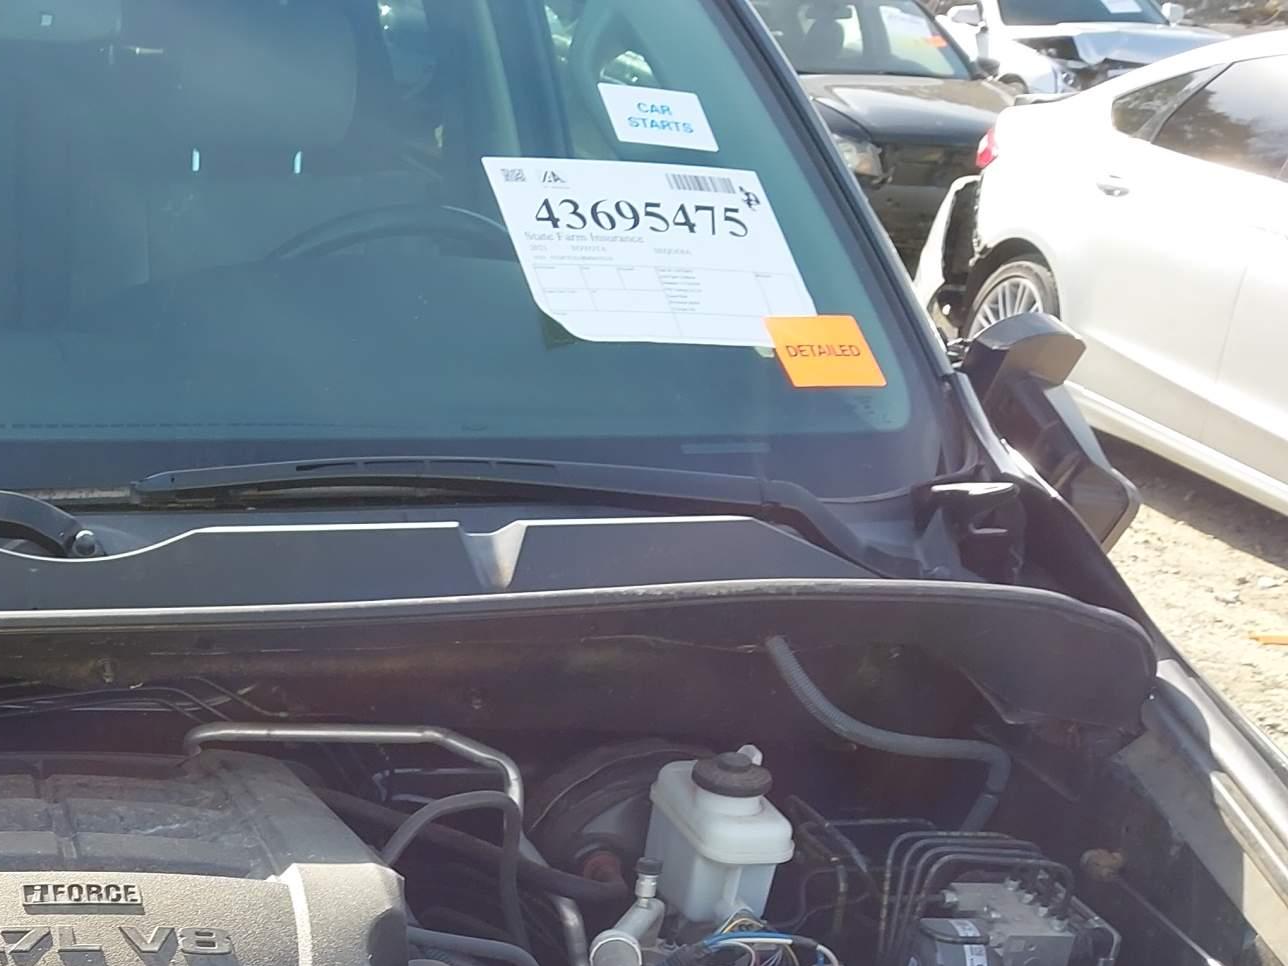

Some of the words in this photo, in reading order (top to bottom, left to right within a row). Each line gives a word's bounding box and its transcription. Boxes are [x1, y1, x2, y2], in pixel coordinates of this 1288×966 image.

[636, 102, 672, 116] CAR
[627, 116, 694, 134] STARTS
[535, 198, 748, 238] 43695475
[556, 232, 588, 242] Farm
[590, 232, 645, 244] Insurance
[785, 344, 861, 358] DETAILED
[117, 926, 233, 954] V8
